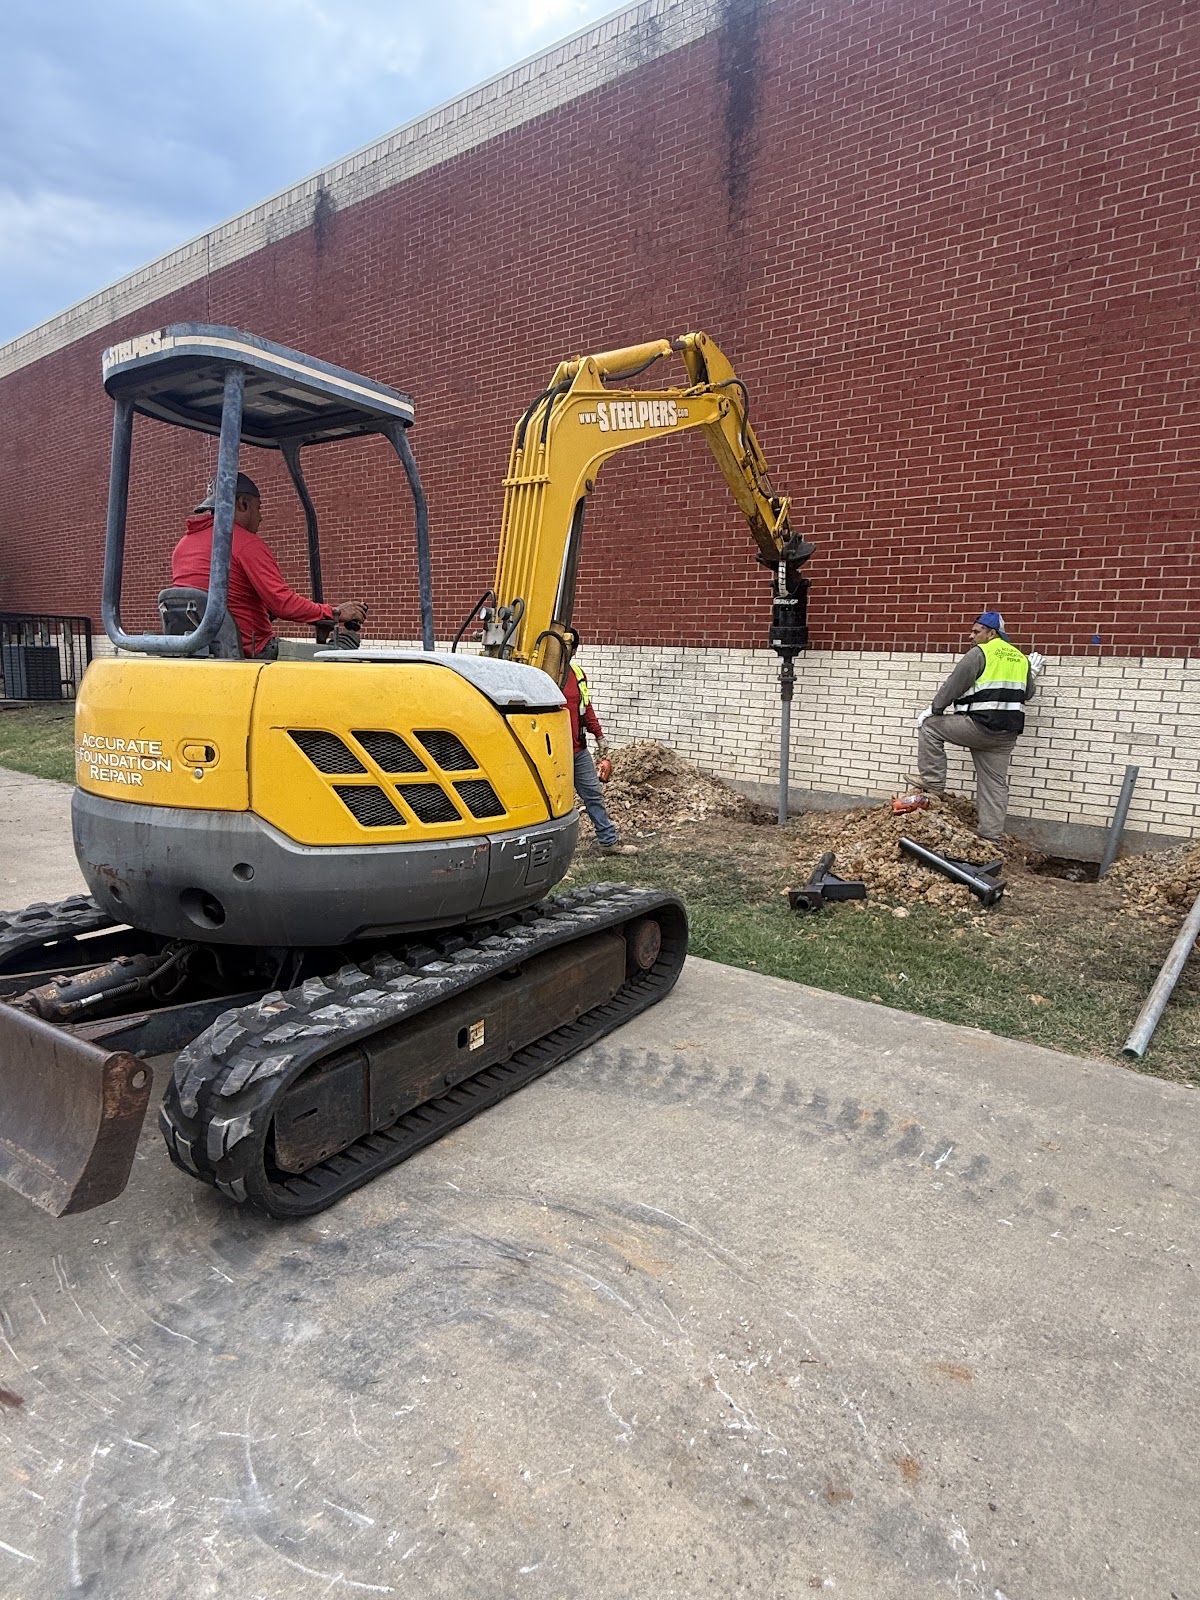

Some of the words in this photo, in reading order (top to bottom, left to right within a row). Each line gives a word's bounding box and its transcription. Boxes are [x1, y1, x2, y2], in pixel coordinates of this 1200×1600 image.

[82, 732, 162, 755] ACCURATE
[79, 746, 172, 773] FOUNDATION
[90, 764, 144, 787] REPAIR
